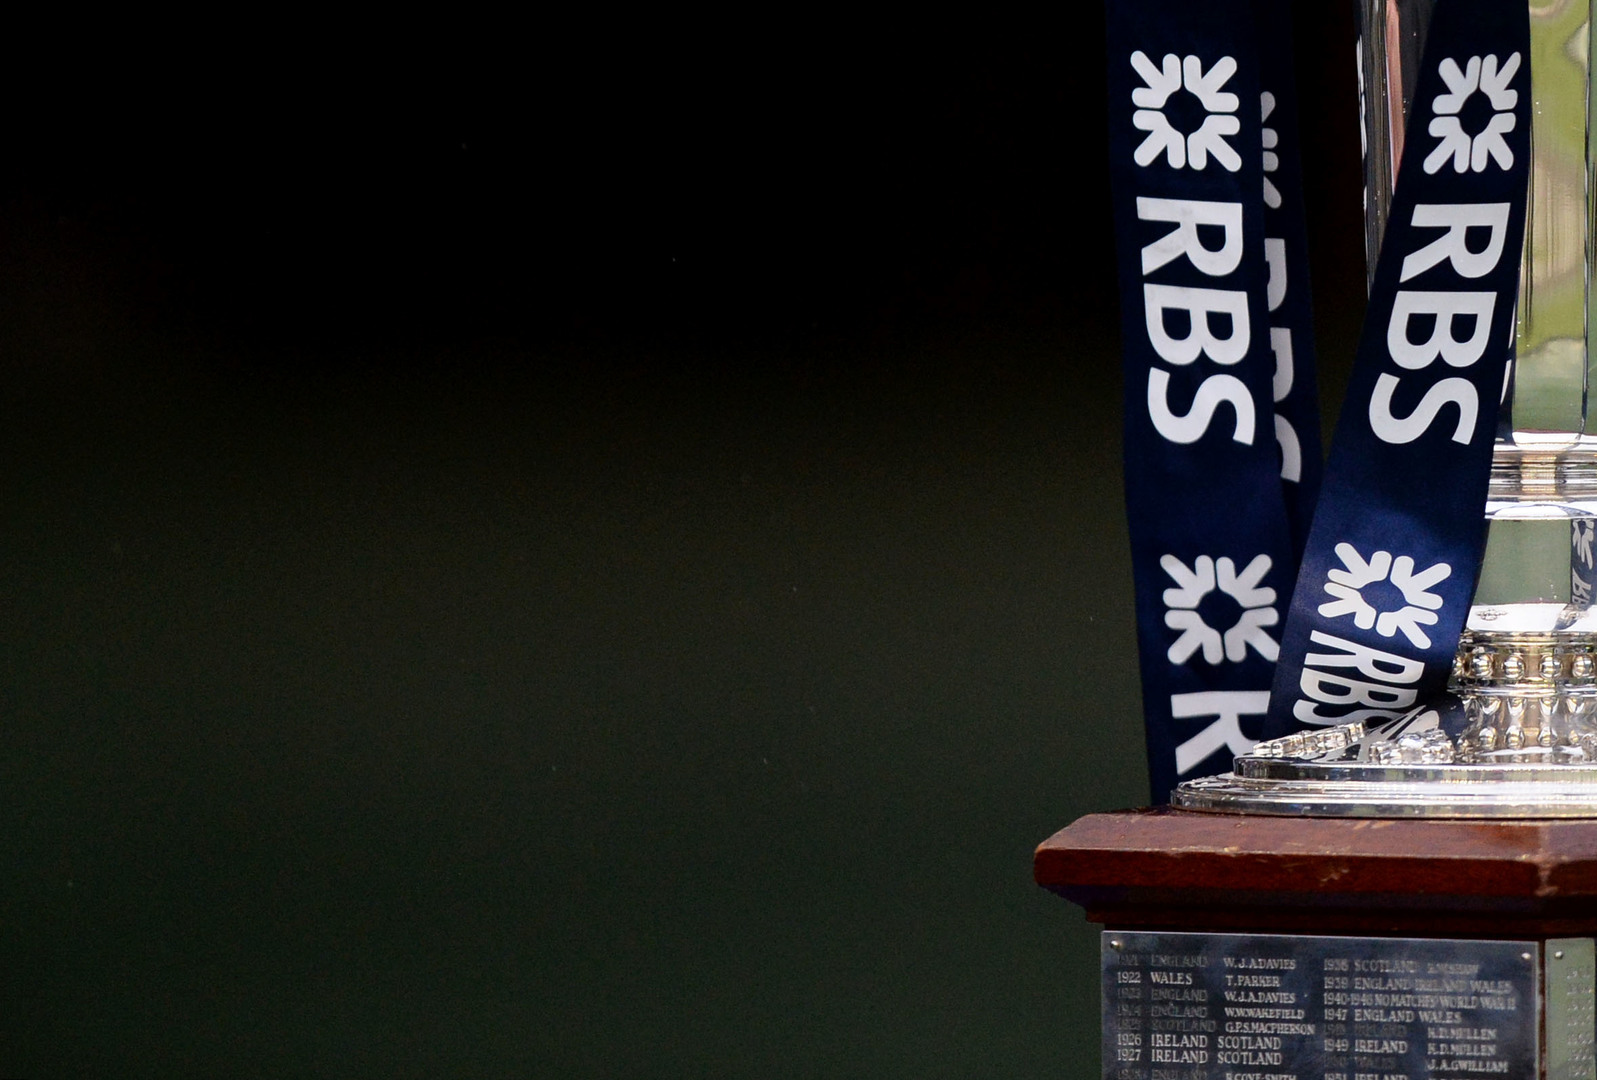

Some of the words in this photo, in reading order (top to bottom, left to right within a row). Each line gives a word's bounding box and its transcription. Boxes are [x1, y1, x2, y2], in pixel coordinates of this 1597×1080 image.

[1135, 195, 1257, 446] RBS
[1367, 201, 1511, 447] RBS
[1292, 629, 1426, 727] RBS
[1354, 959, 1418, 973] SCOTLAND
[1117, 971, 1142, 984] 1922
[1150, 971, 1193, 985] WALES
[1226, 975, 1281, 988] T.PARKER
[1323, 976, 1349, 989] 1939
[1354, 977, 1411, 991] ENGLAND
[1469, 980, 1513, 994] WALES
[1151, 988, 1208, 1001] ENGLAND
[1439, 995, 1478, 1009] WORLD
[1151, 1006, 1208, 1018] ENGLAND
[1323, 1008, 1349, 1021] 1947
[1354, 1009, 1415, 1023] ENGLAND
[1418, 1010, 1462, 1024] WALES
[1117, 1033, 1142, 1046] 1926
[1151, 1034, 1208, 1048] IRELAND
[1217, 1035, 1282, 1050] SCOTLAND
[1323, 1038, 1350, 1052] 1949
[1354, 1039, 1409, 1054] IRELAND
[1117, 1049, 1142, 1061] 1927
[1151, 1049, 1209, 1064] IRELAND
[1217, 1051, 1283, 1065] SCOTLAND
